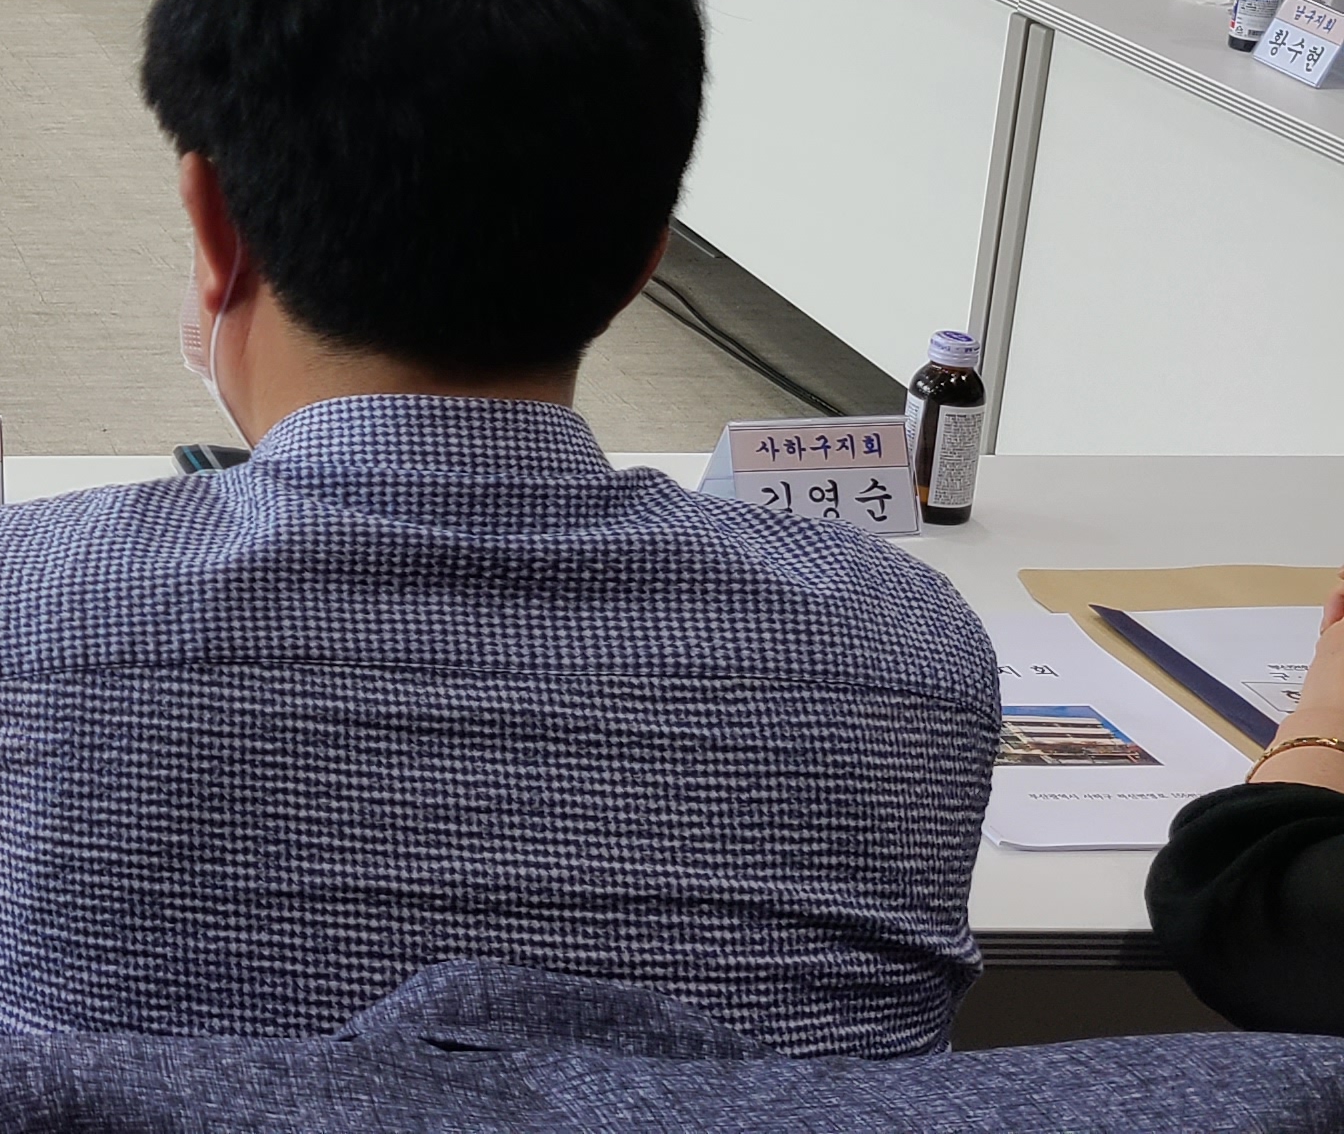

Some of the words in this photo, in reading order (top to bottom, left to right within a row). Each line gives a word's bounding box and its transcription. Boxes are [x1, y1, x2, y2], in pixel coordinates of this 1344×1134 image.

[1294, 4, 1336, 34] 남구지회
[1269, 29, 1325, 72] 황수현
[755, 432, 883, 462] 사하구지회
